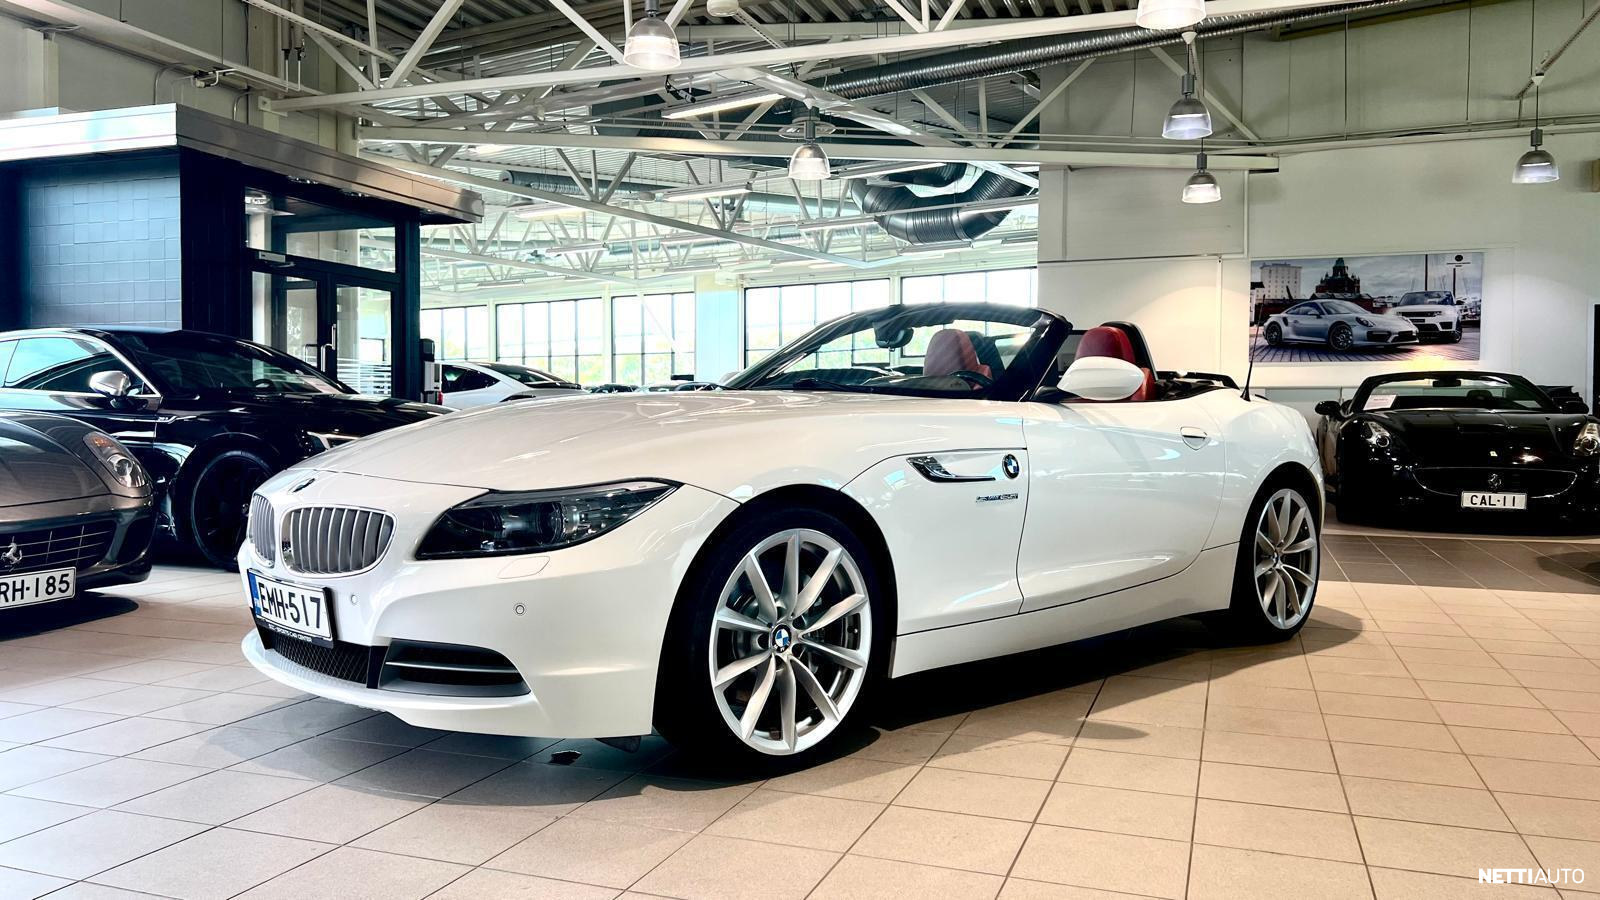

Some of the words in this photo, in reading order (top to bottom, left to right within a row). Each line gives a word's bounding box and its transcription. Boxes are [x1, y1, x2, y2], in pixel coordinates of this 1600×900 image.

[1470, 495, 1516, 507] CAL-11
[0, 573, 70, 603] RH-185
[258, 582, 321, 629] EMH-517
